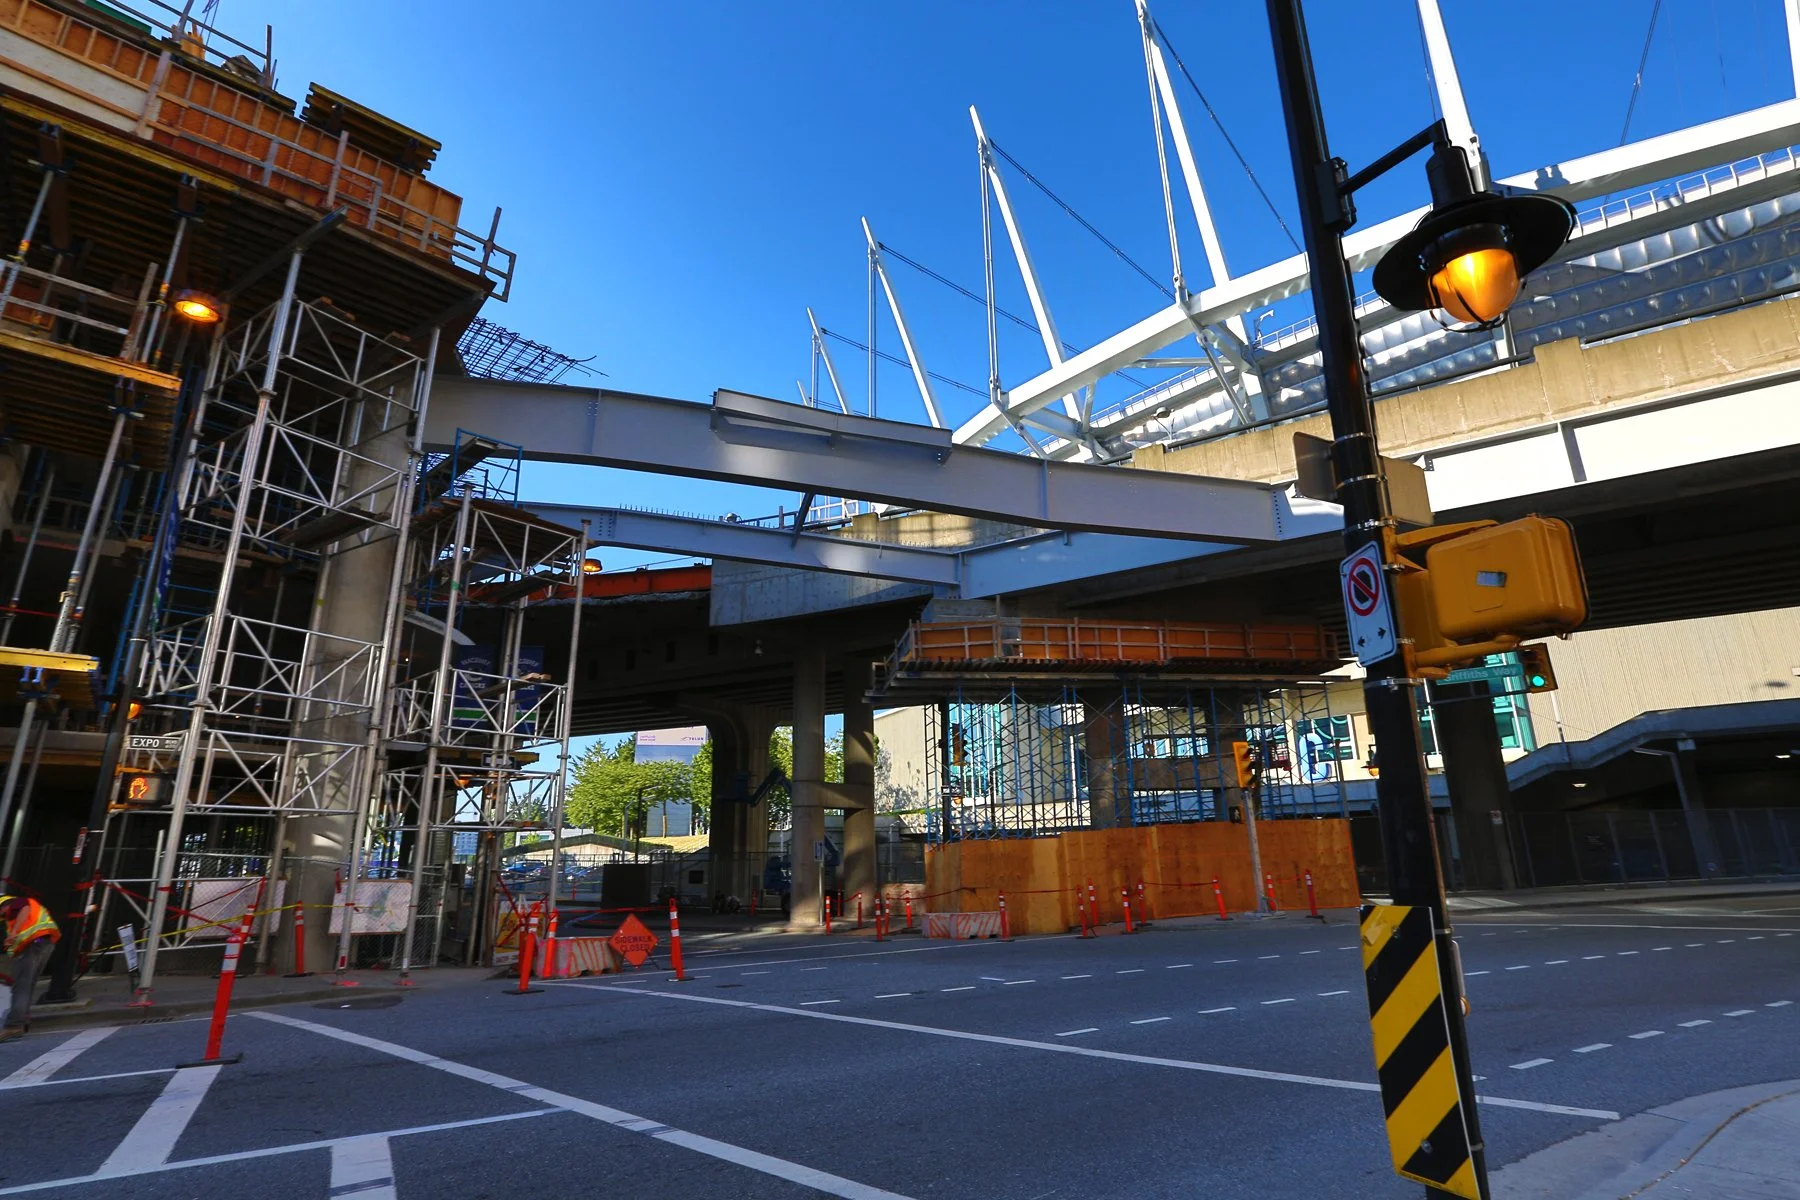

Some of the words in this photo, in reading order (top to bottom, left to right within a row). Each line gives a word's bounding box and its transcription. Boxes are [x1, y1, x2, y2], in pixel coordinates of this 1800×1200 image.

[1493, 667, 1517, 675] Way
[131, 738, 160, 748] EXPO
[615, 935, 653, 944] SIDEWALK
[620, 943, 649, 953] CLOSED
